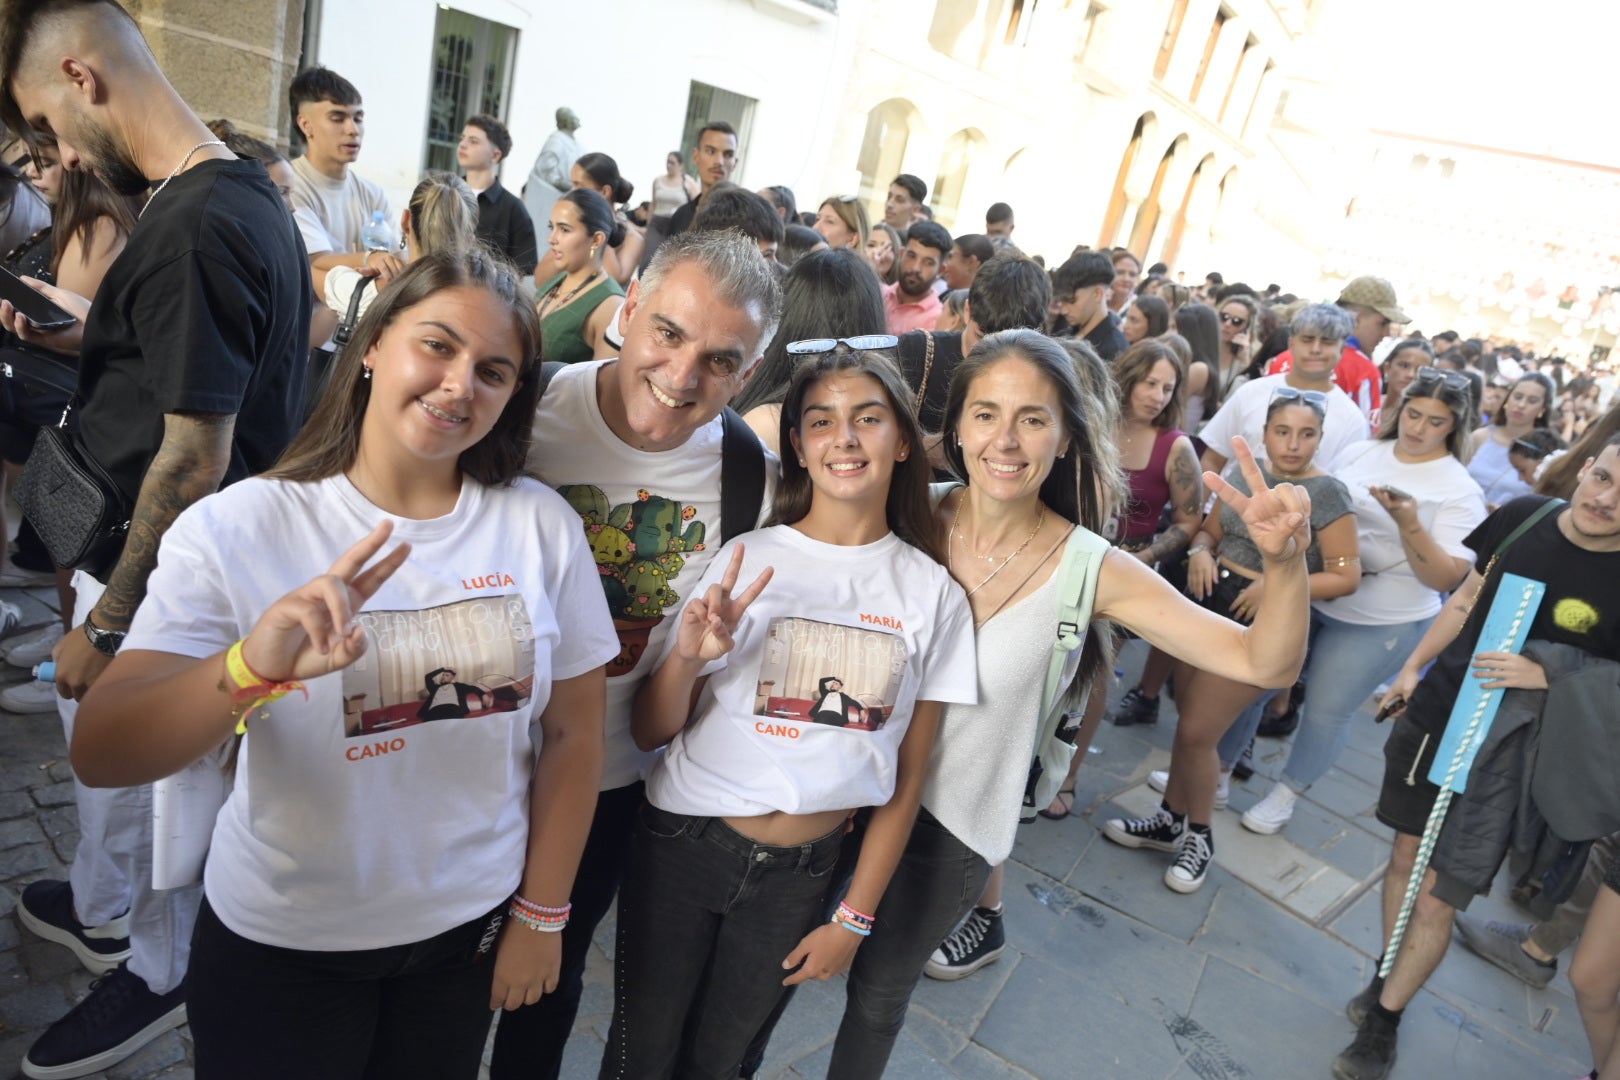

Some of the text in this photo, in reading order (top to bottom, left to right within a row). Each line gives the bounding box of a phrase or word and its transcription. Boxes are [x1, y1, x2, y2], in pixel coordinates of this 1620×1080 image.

[462, 571, 515, 590] LUCÍA
[352, 600, 524, 636] RIANA TOUR
[859, 613, 904, 631] MARÍA
[378, 631, 441, 653] CANO
[771, 620, 906, 657] TRIANA TOUR
[792, 637, 841, 662] CANO
[755, 720, 800, 739] CANO
[345, 737, 406, 761] CANO
